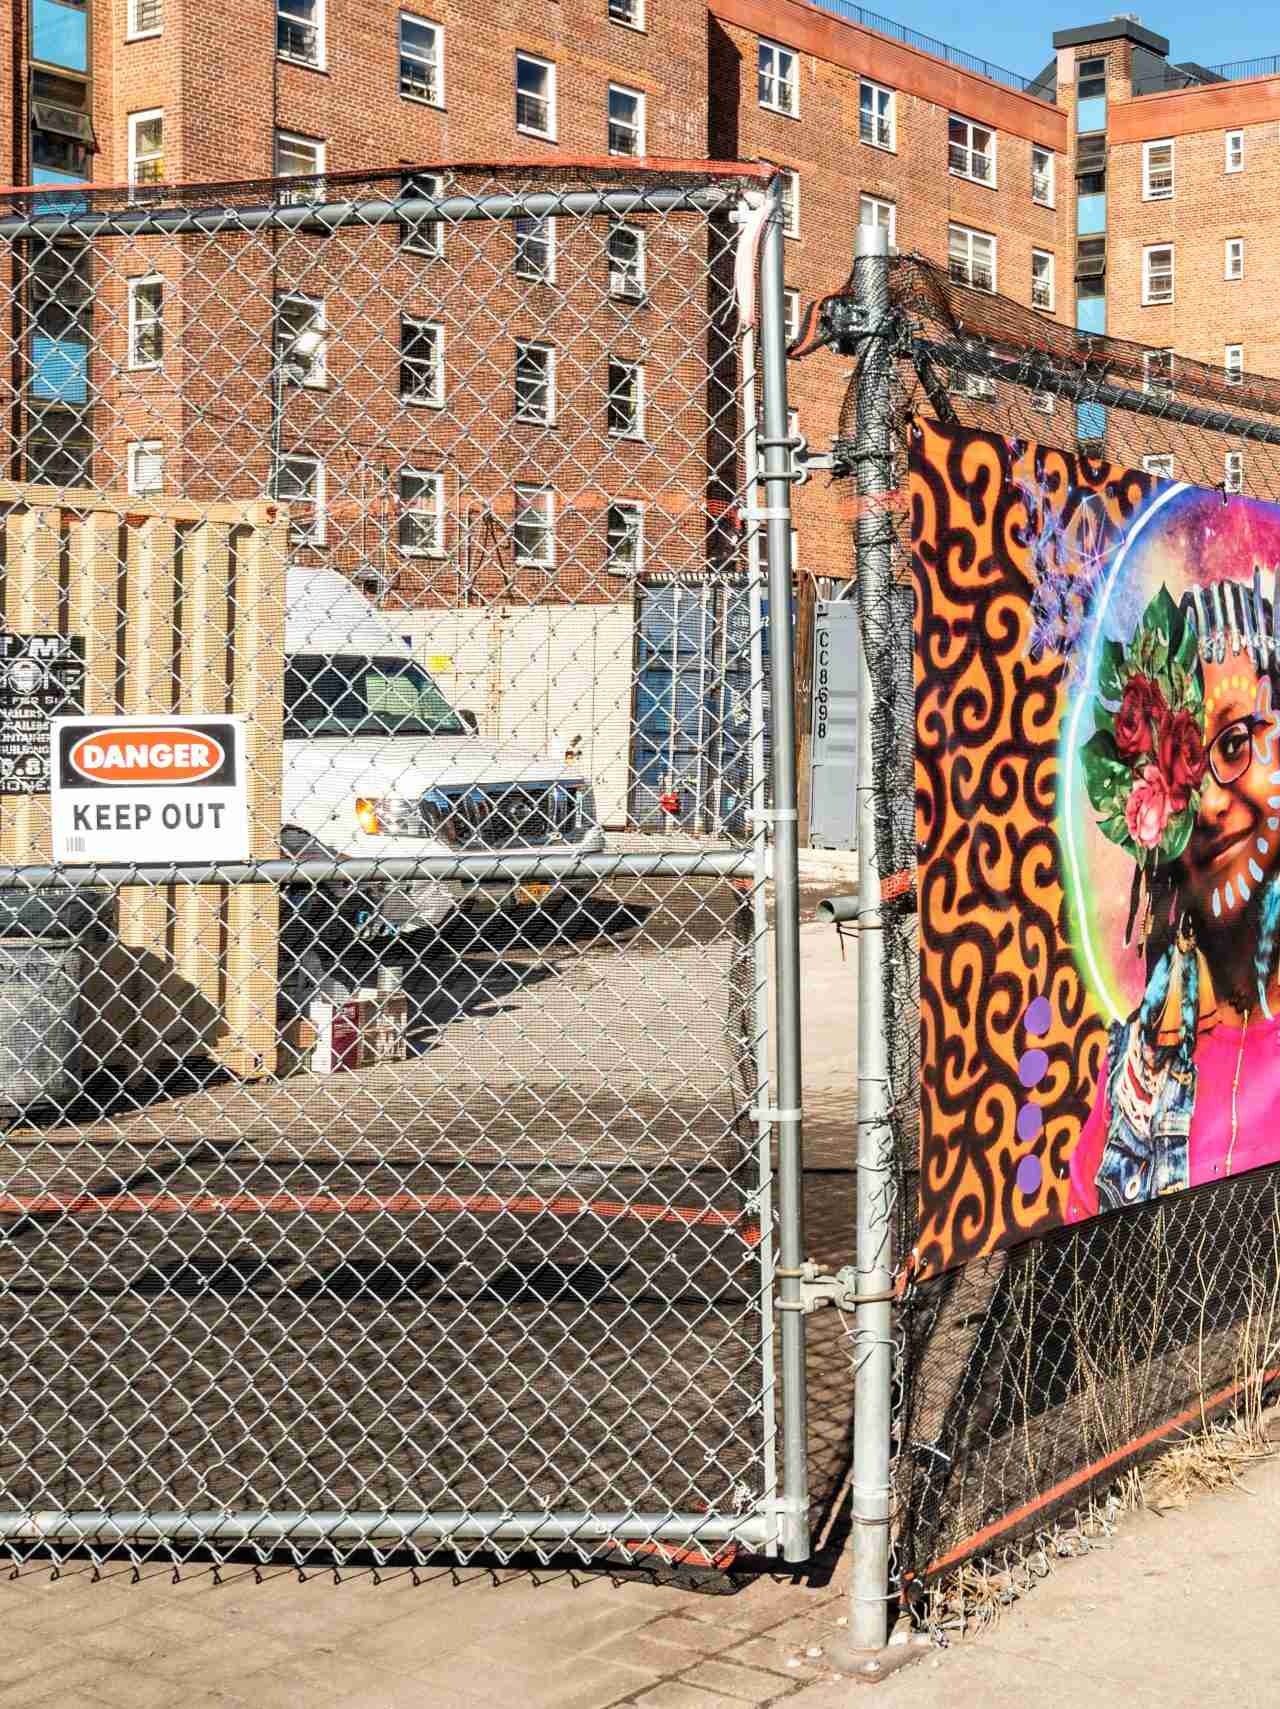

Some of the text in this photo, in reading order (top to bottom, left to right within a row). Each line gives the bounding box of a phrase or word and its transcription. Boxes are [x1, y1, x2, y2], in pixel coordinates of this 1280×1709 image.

[82, 743, 211, 770] DANGER
[73, 802, 226, 831] KEEP OUT
